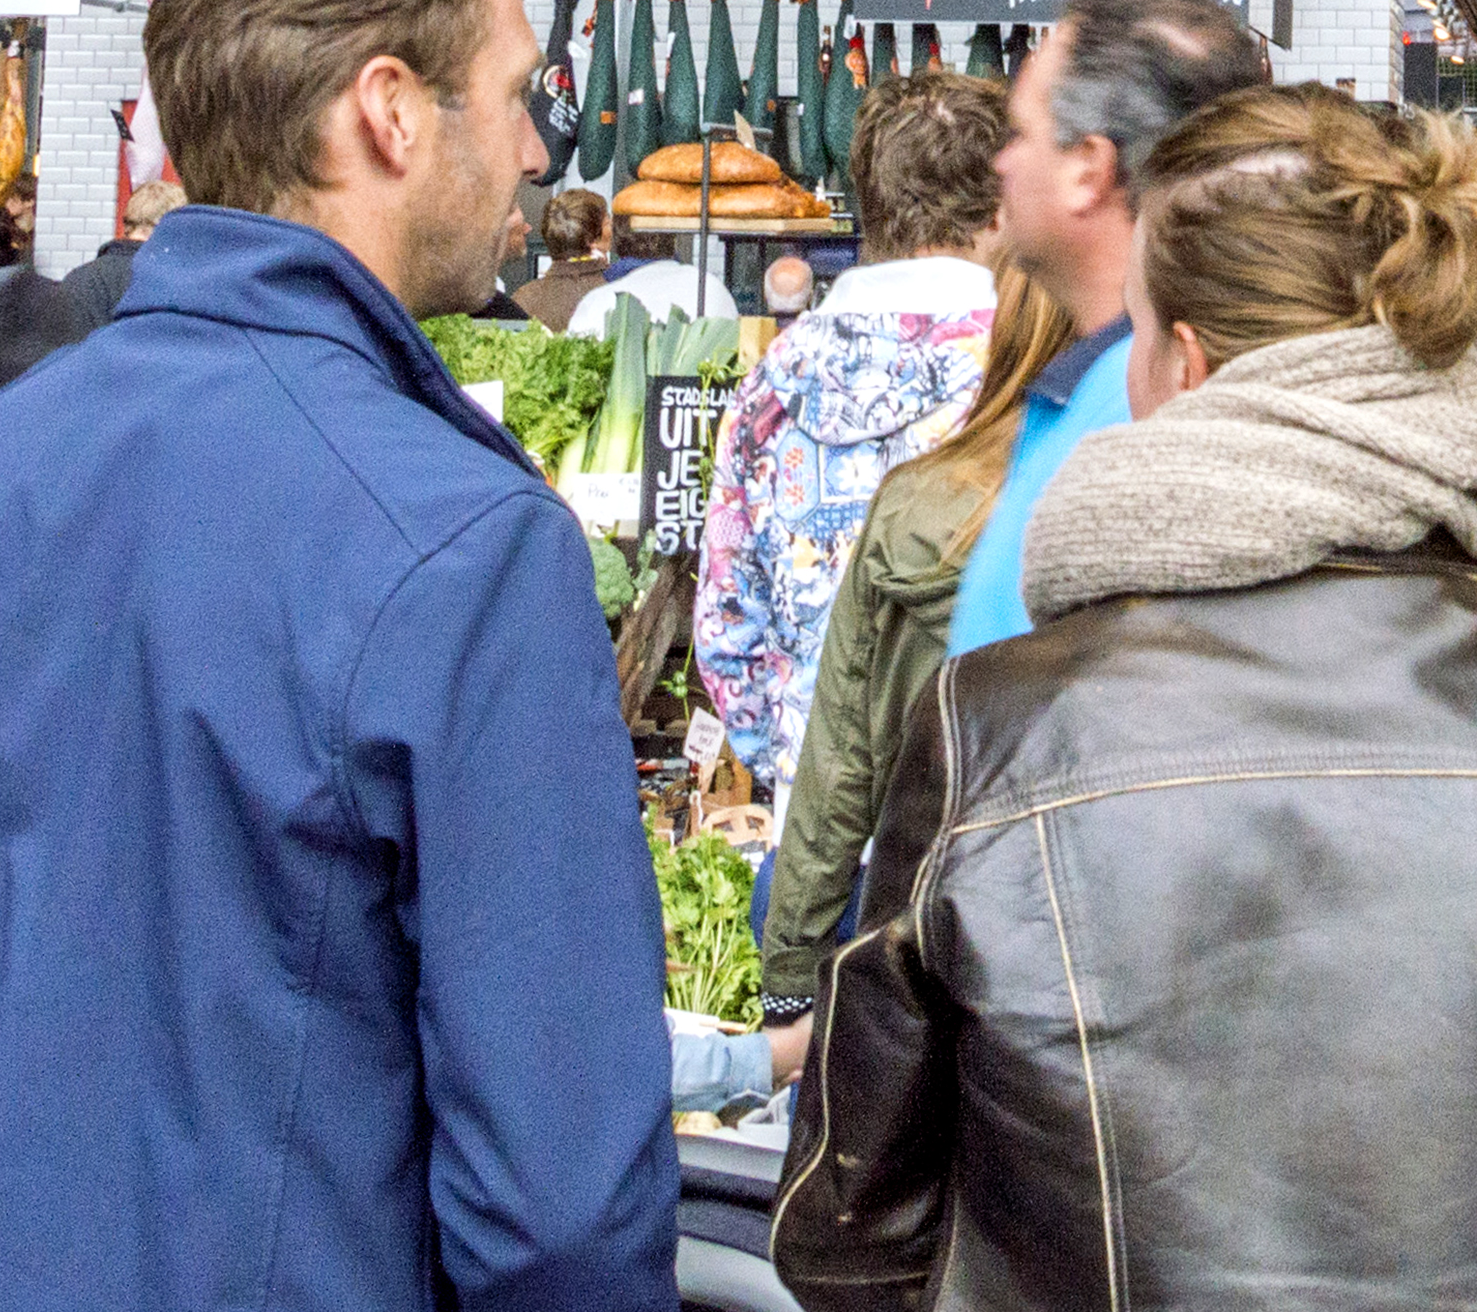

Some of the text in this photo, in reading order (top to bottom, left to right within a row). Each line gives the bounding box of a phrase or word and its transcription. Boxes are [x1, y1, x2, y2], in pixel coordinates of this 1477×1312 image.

[659, 407, 718, 449] UIT
[656, 449, 704, 491] JE
[654, 487, 706, 522] EIG
[654, 521, 705, 557] ST
